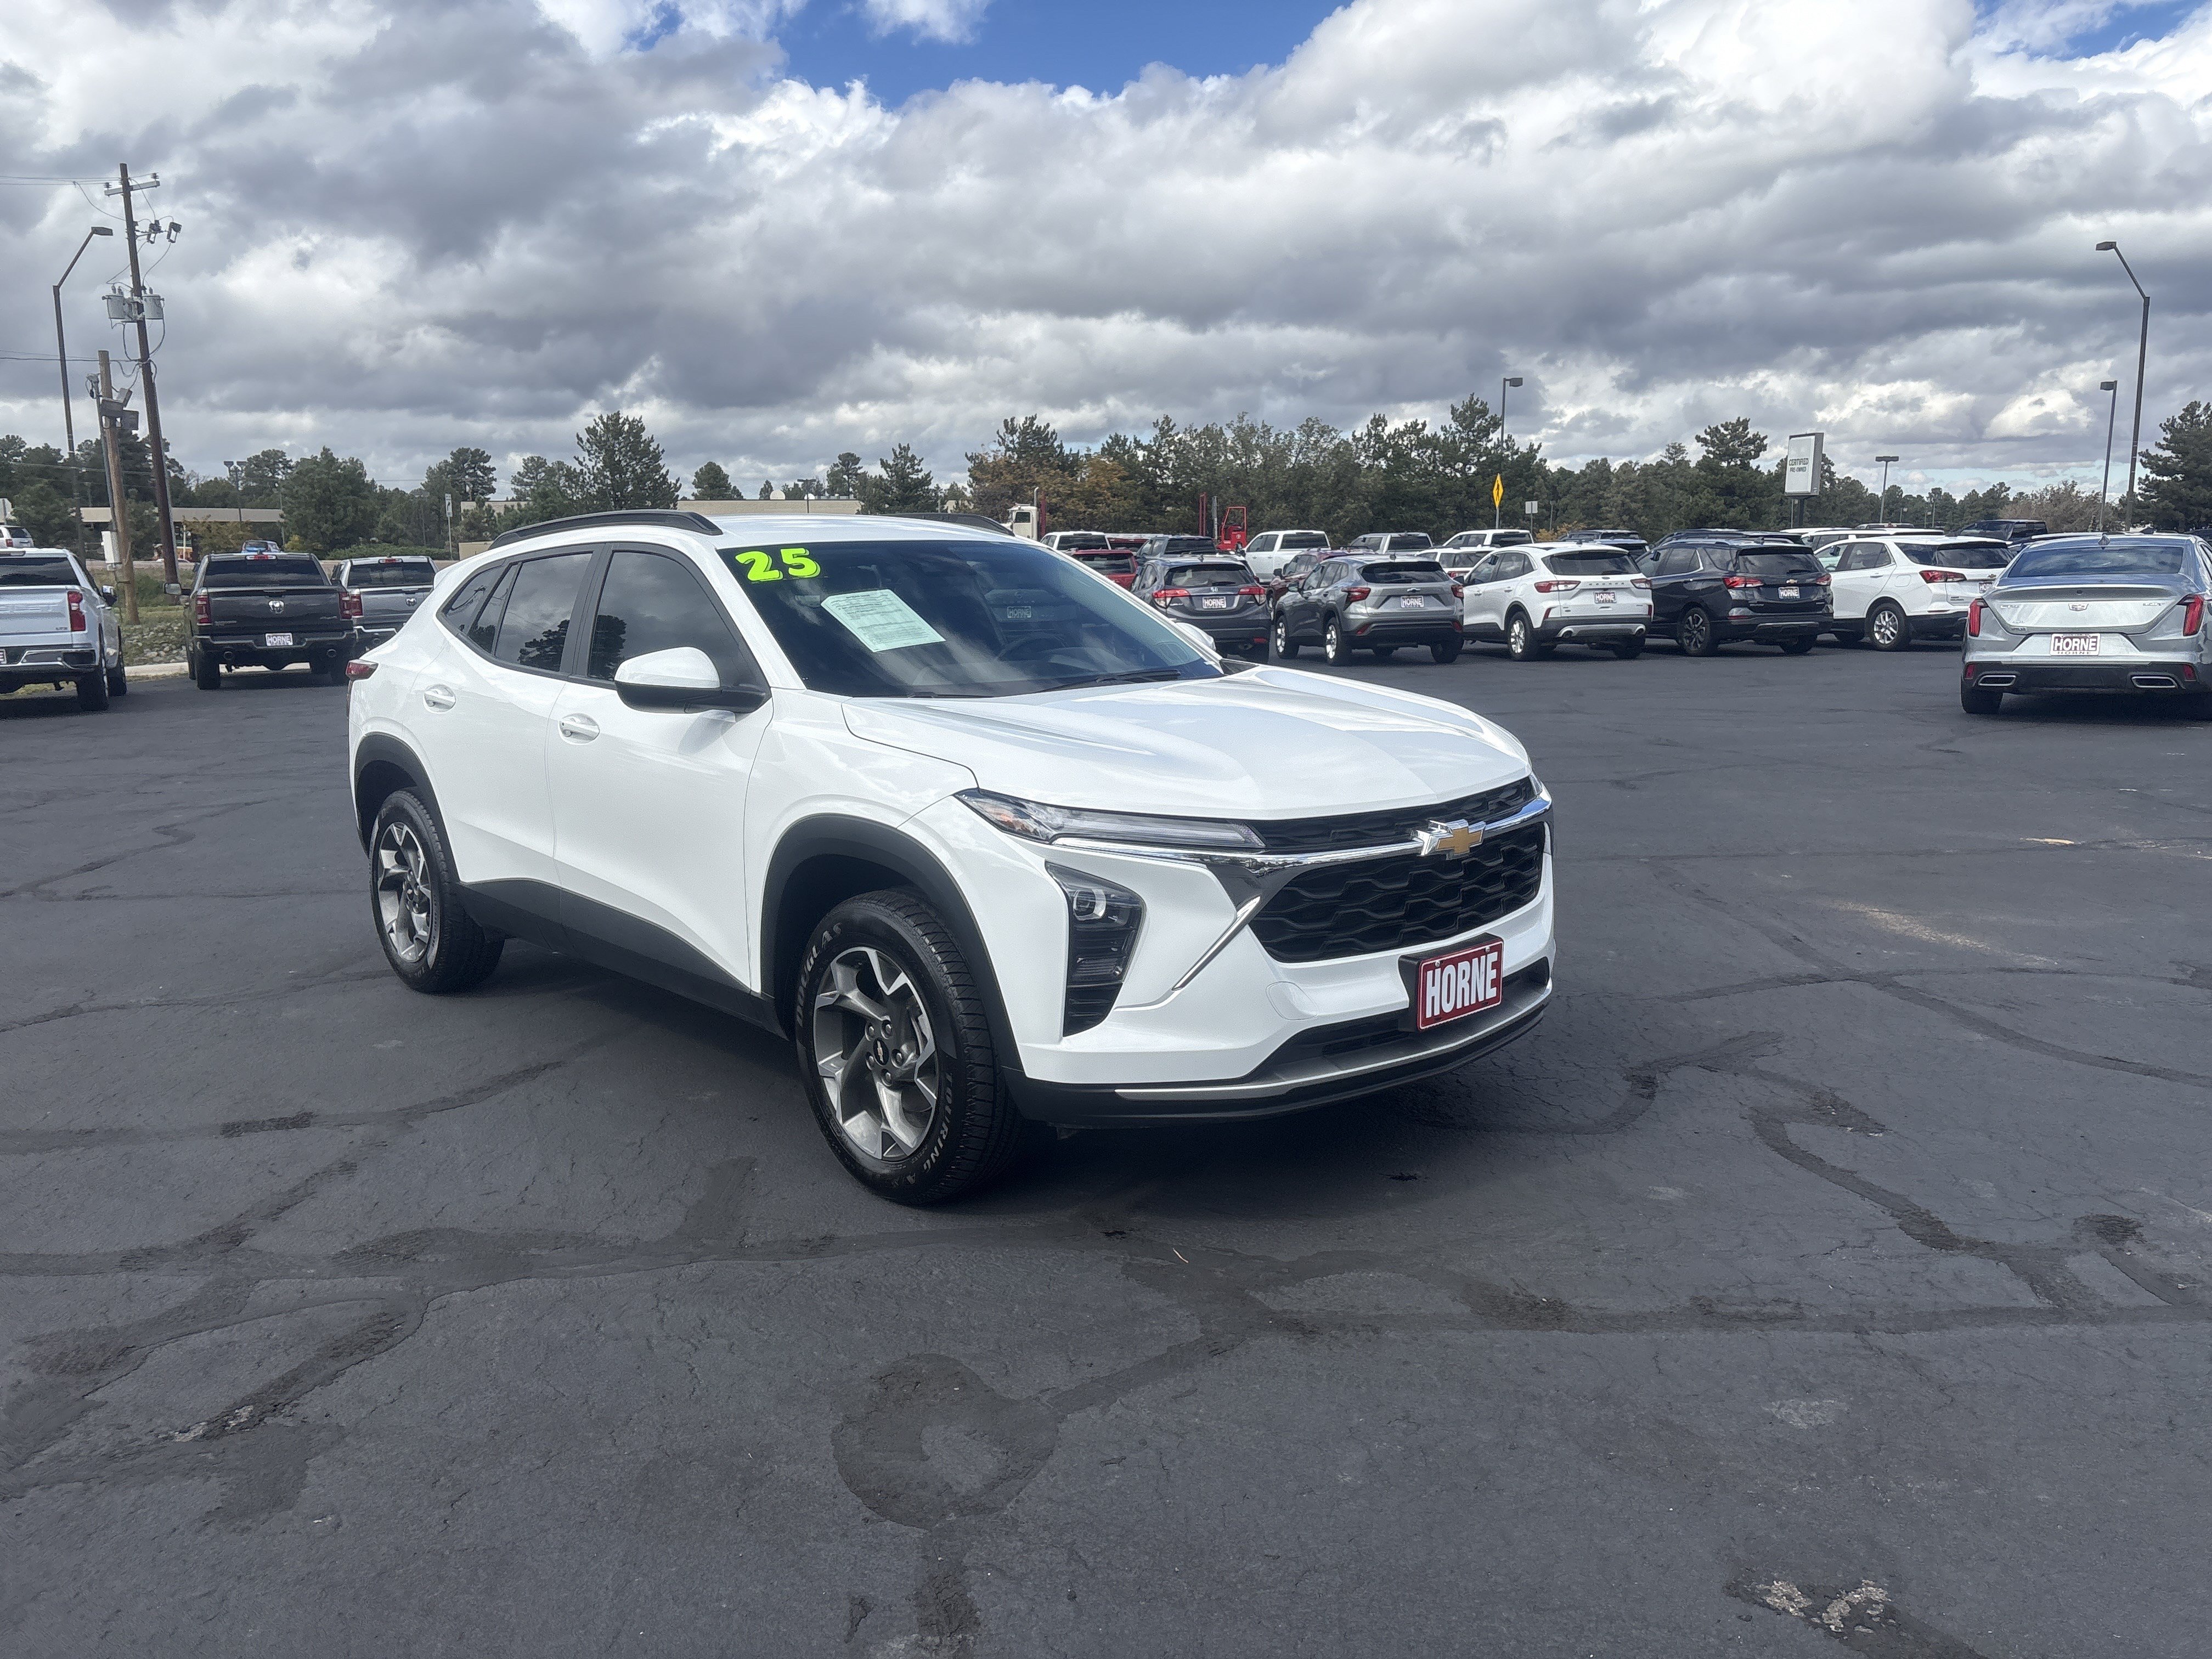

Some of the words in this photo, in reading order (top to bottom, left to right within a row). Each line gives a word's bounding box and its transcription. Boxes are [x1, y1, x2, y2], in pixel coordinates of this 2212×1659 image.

[735, 548, 821, 583] 25
[1595, 593, 1615, 601] HORNE
[1779, 589, 1799, 597] HORNE
[1402, 597, 1422, 606] HORNE
[267, 635, 291, 644] HORNE
[2054, 638, 2097, 651] HORNE
[796, 922, 843, 1028] DOUGLAS
[1425, 951, 1498, 1019] HORNE
[923, 1072, 953, 1173] TOURING
